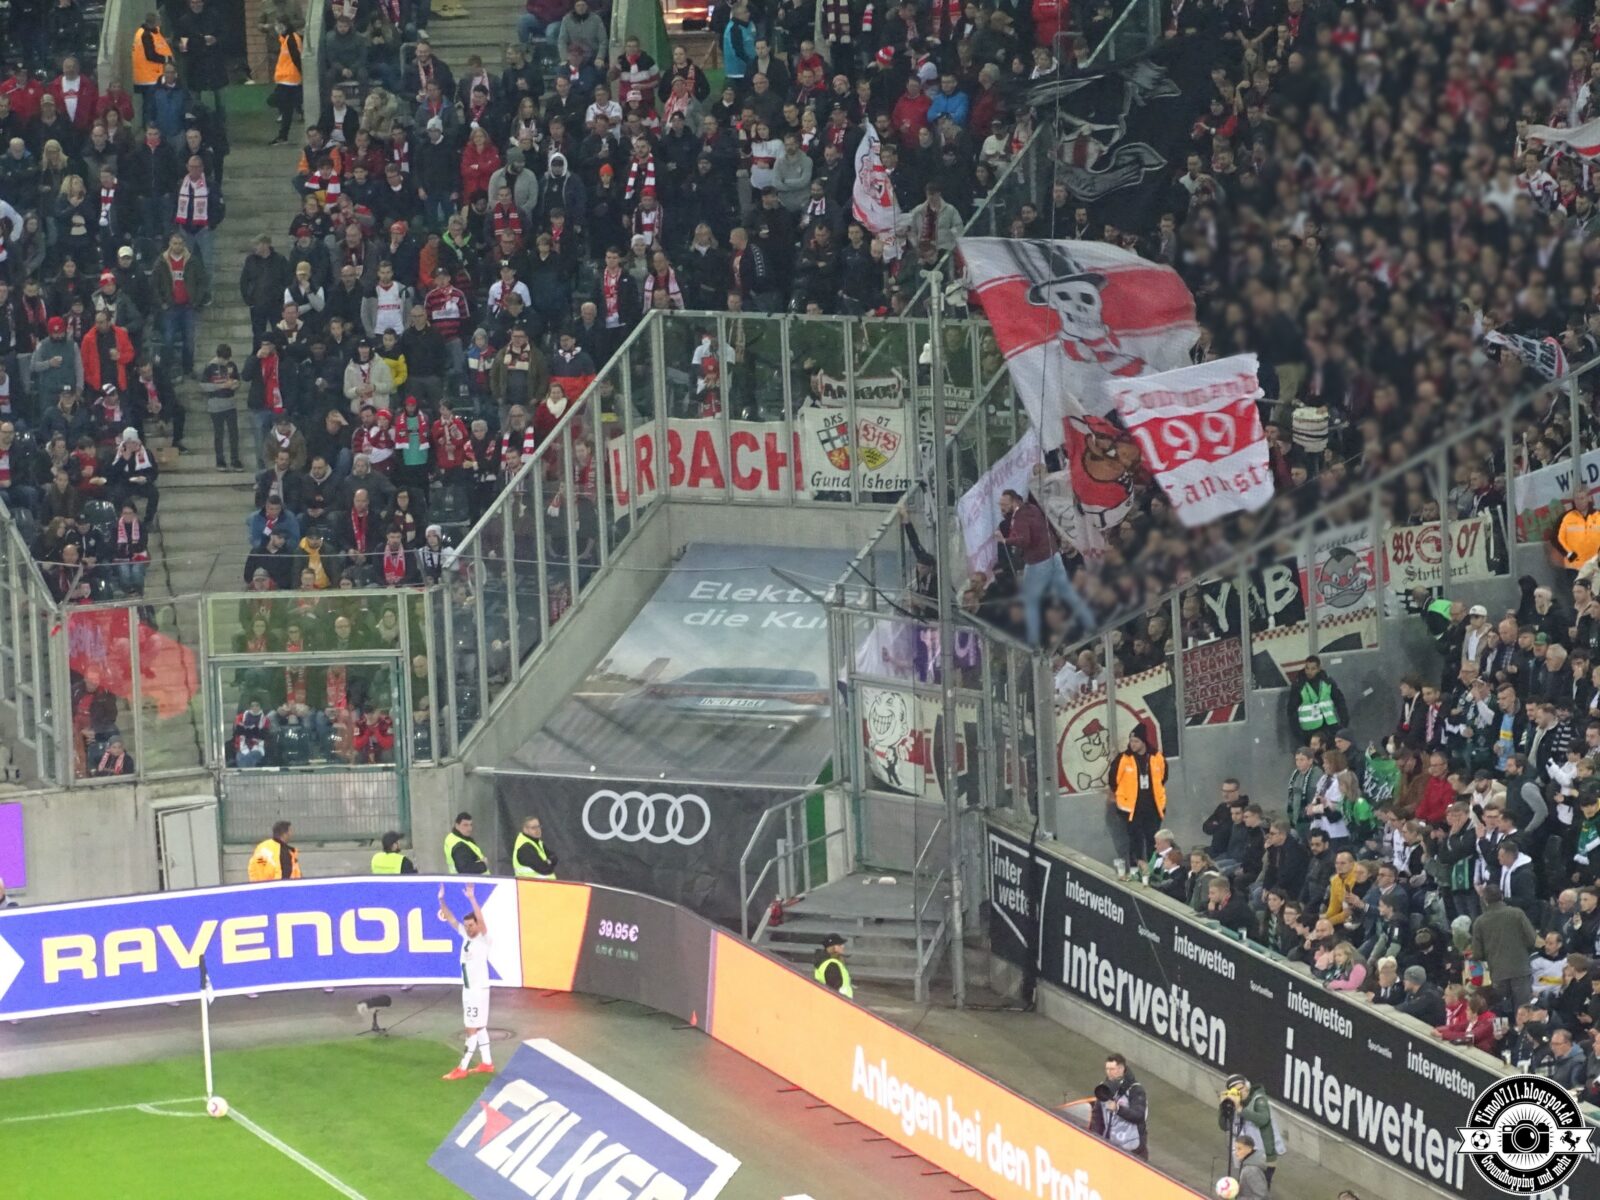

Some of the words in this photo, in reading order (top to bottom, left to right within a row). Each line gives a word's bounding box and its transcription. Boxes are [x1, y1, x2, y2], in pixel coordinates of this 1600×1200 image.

[811, 471, 911, 490] Gundlsheim
[1402, 561, 1469, 584] Stuttart
[683, 608, 749, 627] die
[994, 841, 1022, 885] inter
[42, 906, 453, 984] RAVENOL
[598, 919, 639, 942] 39,95€
[1065, 872, 1124, 925] interwetten
[1174, 926, 1236, 980] interwetten
[1287, 982, 1353, 1039] interwetten
[1408, 1042, 1476, 1101] interwetten
[466, 1006, 479, 1018] 23
[1063, 915, 1226, 1066] interwetten
[1283, 1027, 1465, 1190] interwetten
[852, 1045, 943, 1136] Anlegen
[946, 1095, 982, 1163] bei
[986, 1123, 1032, 1191] den
